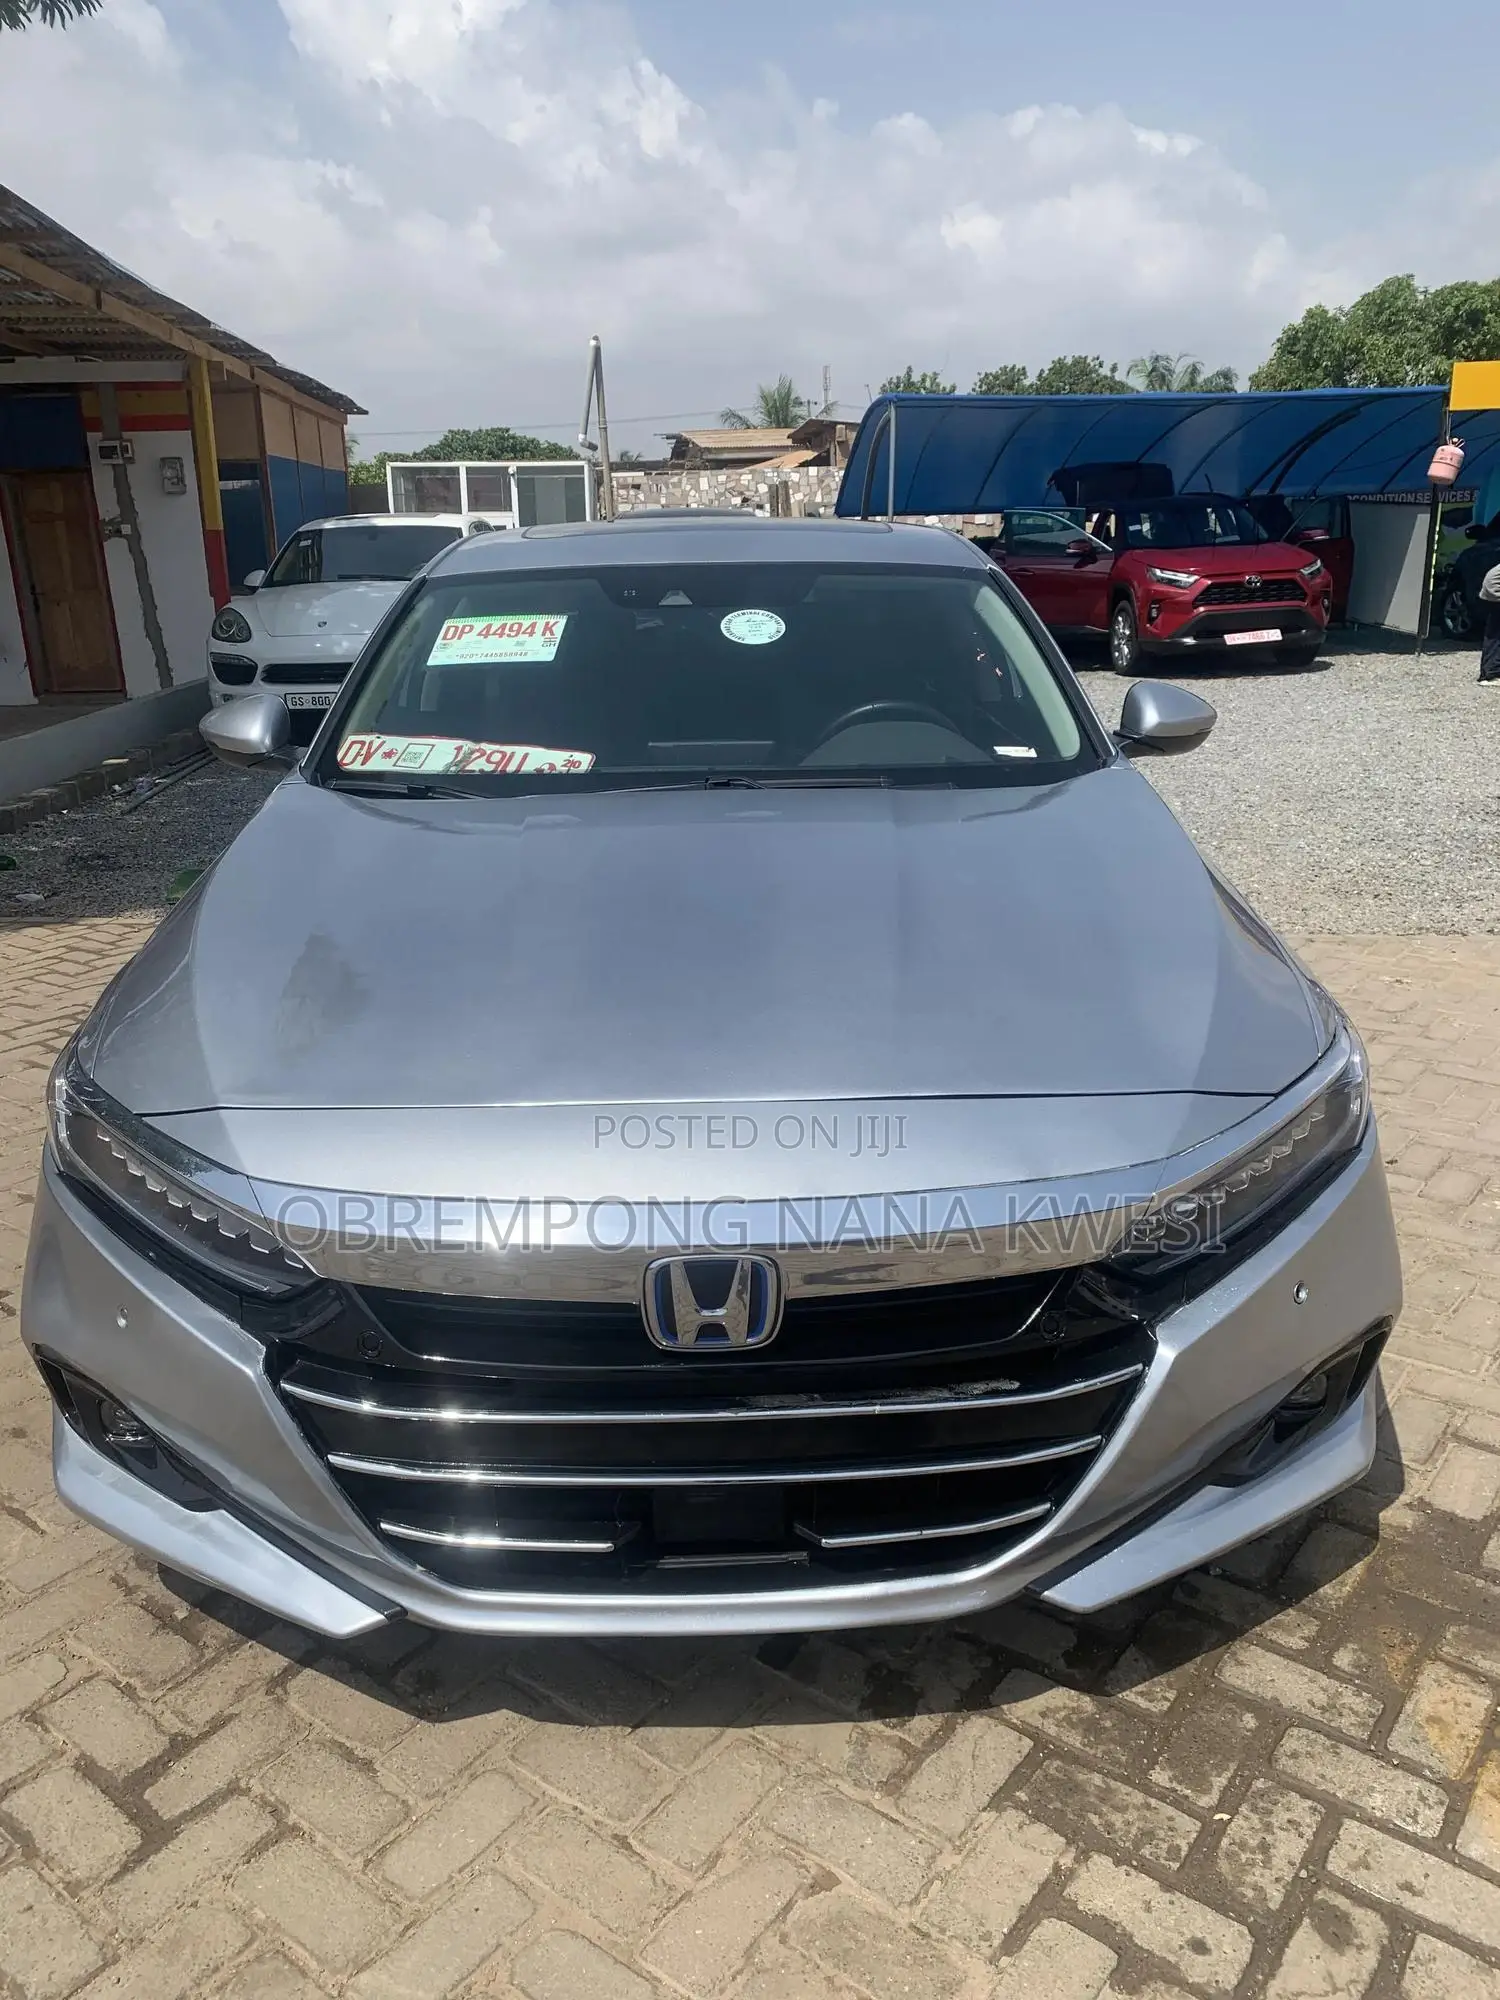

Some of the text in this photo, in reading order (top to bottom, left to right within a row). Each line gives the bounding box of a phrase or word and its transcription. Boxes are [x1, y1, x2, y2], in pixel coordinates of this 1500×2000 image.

[1416, 490, 1471, 503] SEVICES
[441, 620, 560, 641] DP 4494 K
[291, 696, 304, 706] GS
[339, 739, 385, 767] DV
